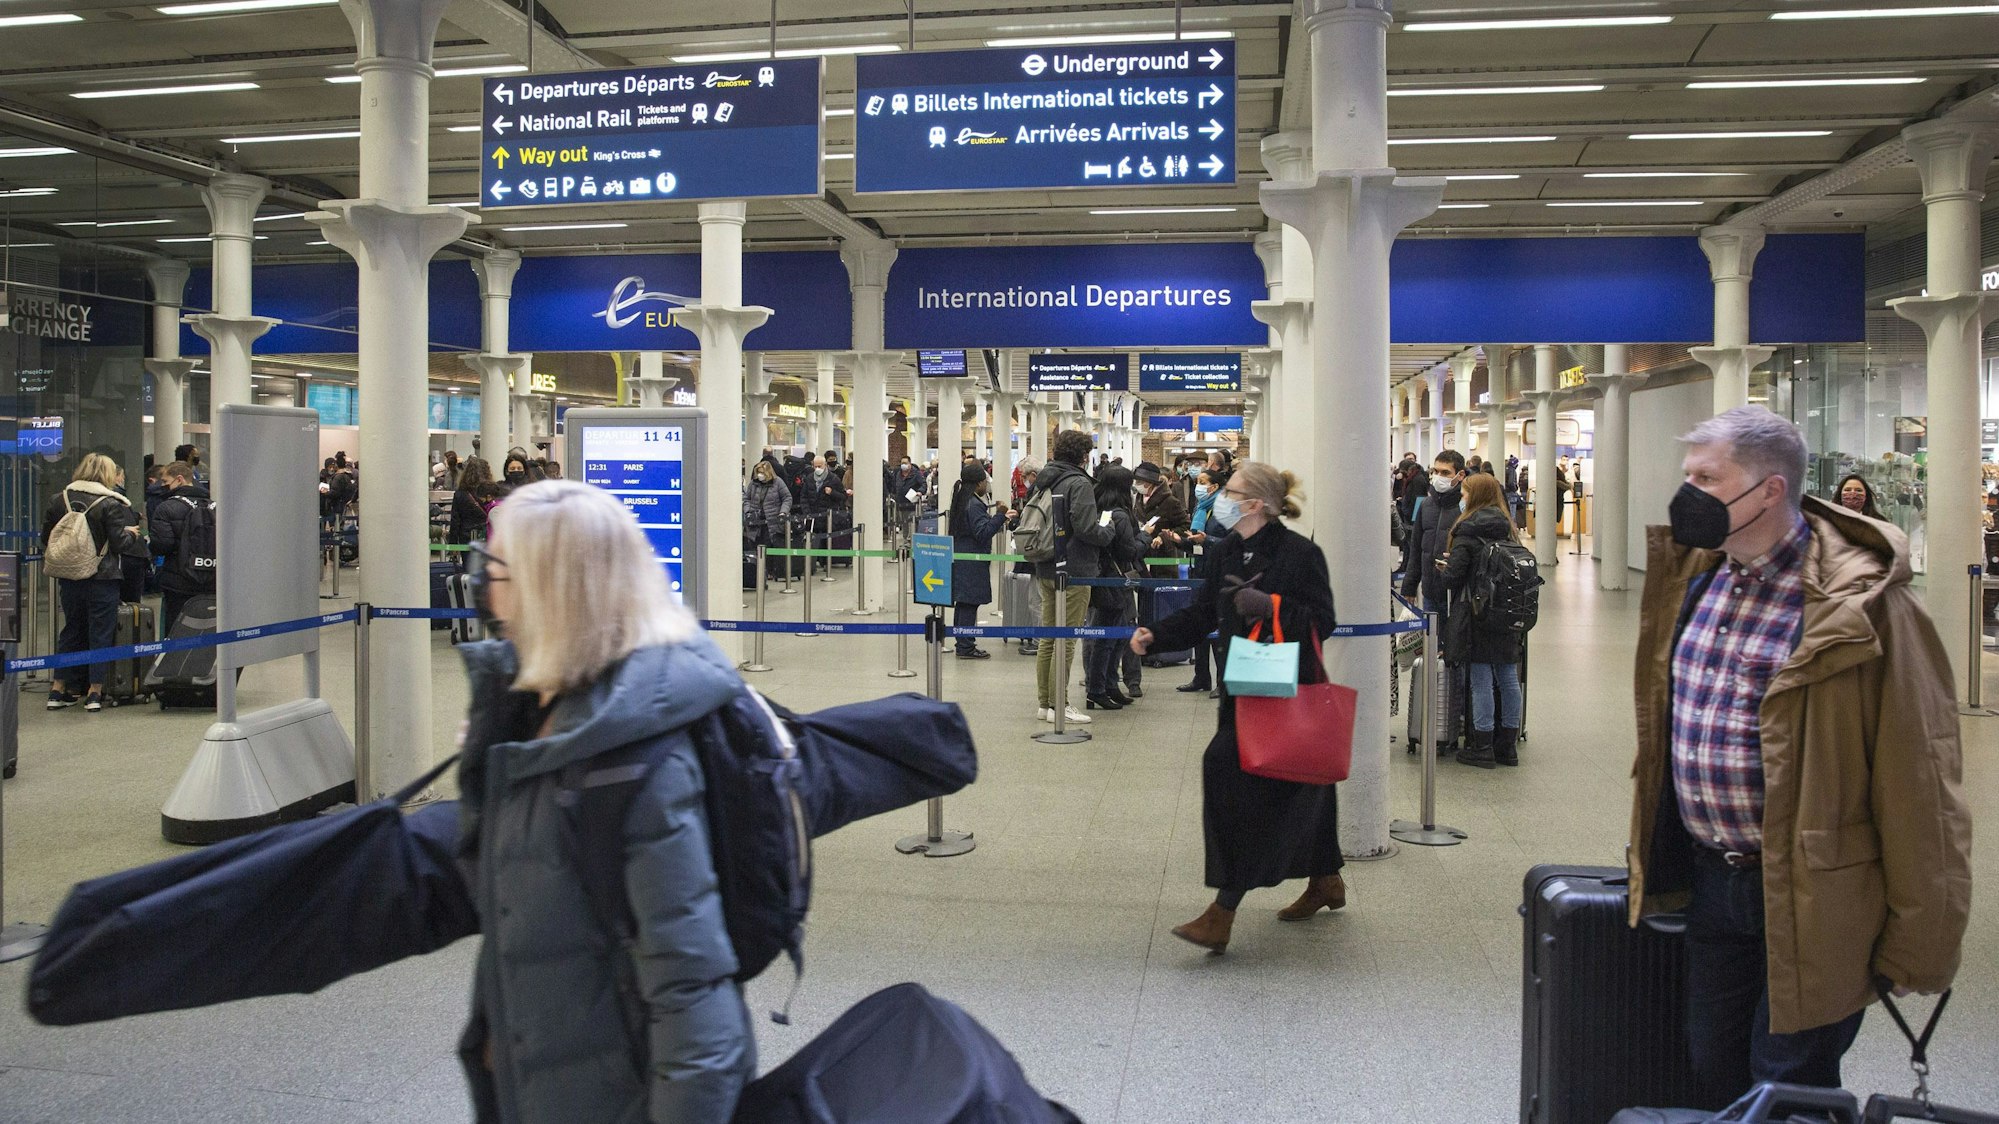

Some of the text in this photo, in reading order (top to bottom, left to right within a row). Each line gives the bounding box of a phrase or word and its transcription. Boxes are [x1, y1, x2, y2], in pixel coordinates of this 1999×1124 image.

[1053, 51, 1189, 76] Underground
[520, 74, 749, 102] Departures Départs EUROSTAR
[638, 103, 686, 115] Tickets and
[914, 86, 1189, 113] Billets International tickets
[519, 109, 632, 132] National Rail
[637, 115, 680, 127] platforms
[970, 122, 1189, 145] EUROSTAR Arrivées Arrivals
[519, 145, 646, 167] Way out King's Cross
[918, 284, 1232, 312] International Departures
[645, 312, 677, 328] EU
[1070, 364, 1092, 372] Départs
[644, 431, 659, 441] 11
[665, 431, 681, 441] 41
